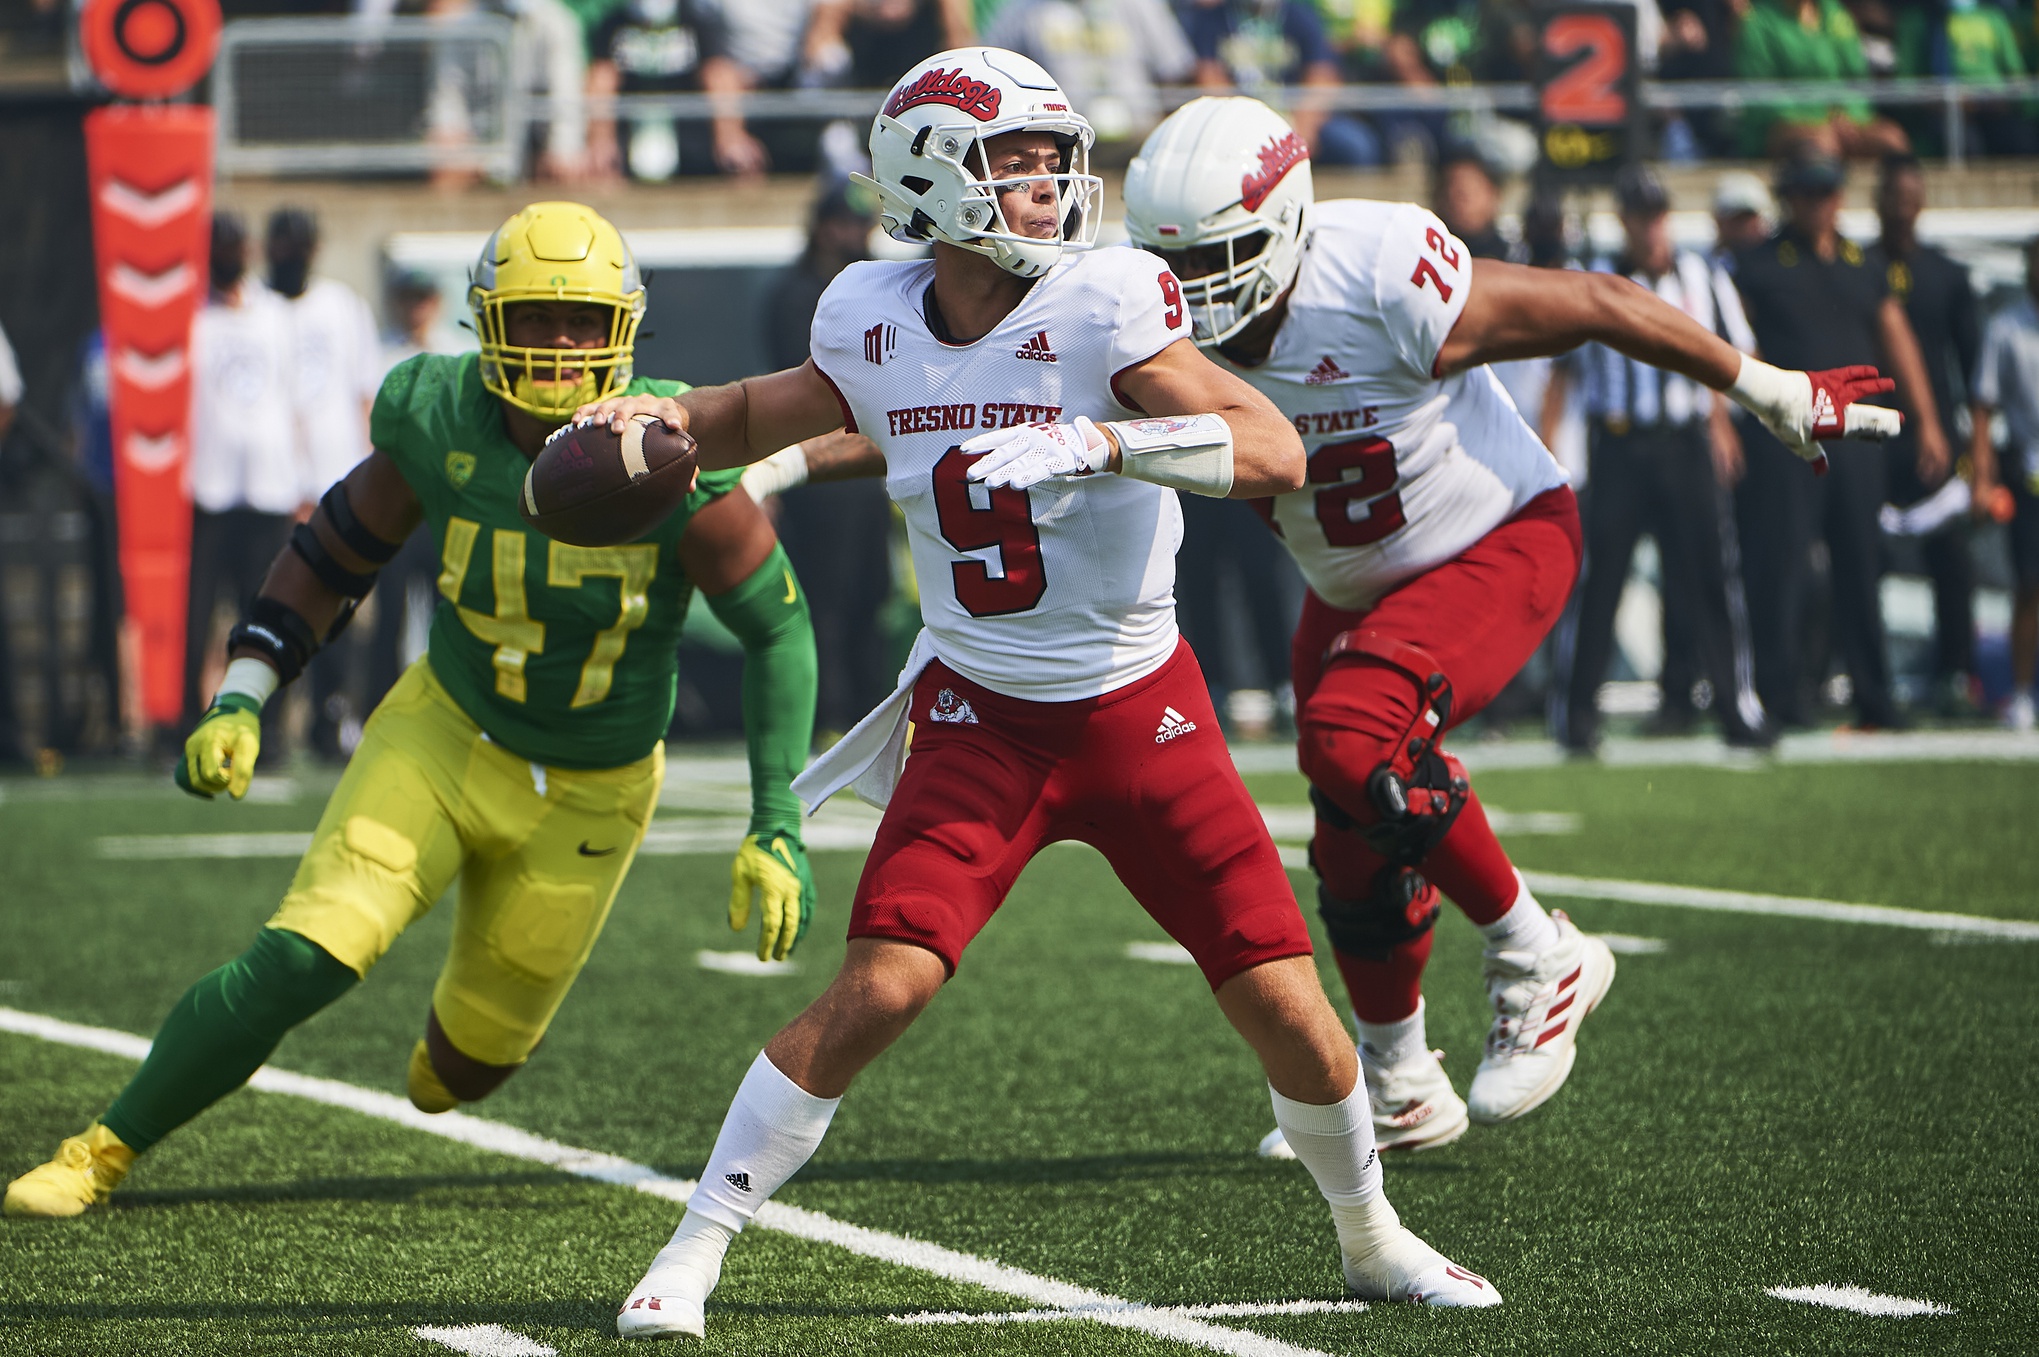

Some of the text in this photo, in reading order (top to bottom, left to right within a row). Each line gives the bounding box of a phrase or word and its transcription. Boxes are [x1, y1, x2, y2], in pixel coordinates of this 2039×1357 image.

[882, 67, 1002, 122] Bulldogs
[1540, 13, 1626, 124] 2
[1411, 227, 1459, 303] 72
[1157, 270, 1183, 331] 9
[1015, 349, 1057, 363] adidas
[887, 403, 1063, 437] FRESNO STATE
[1295, 406, 1379, 436] STATE
[932, 445, 1048, 618] 9
[437, 515, 660, 710] 47
[1155, 721, 1197, 744] adidas
[725, 1174, 752, 1193] adidas
